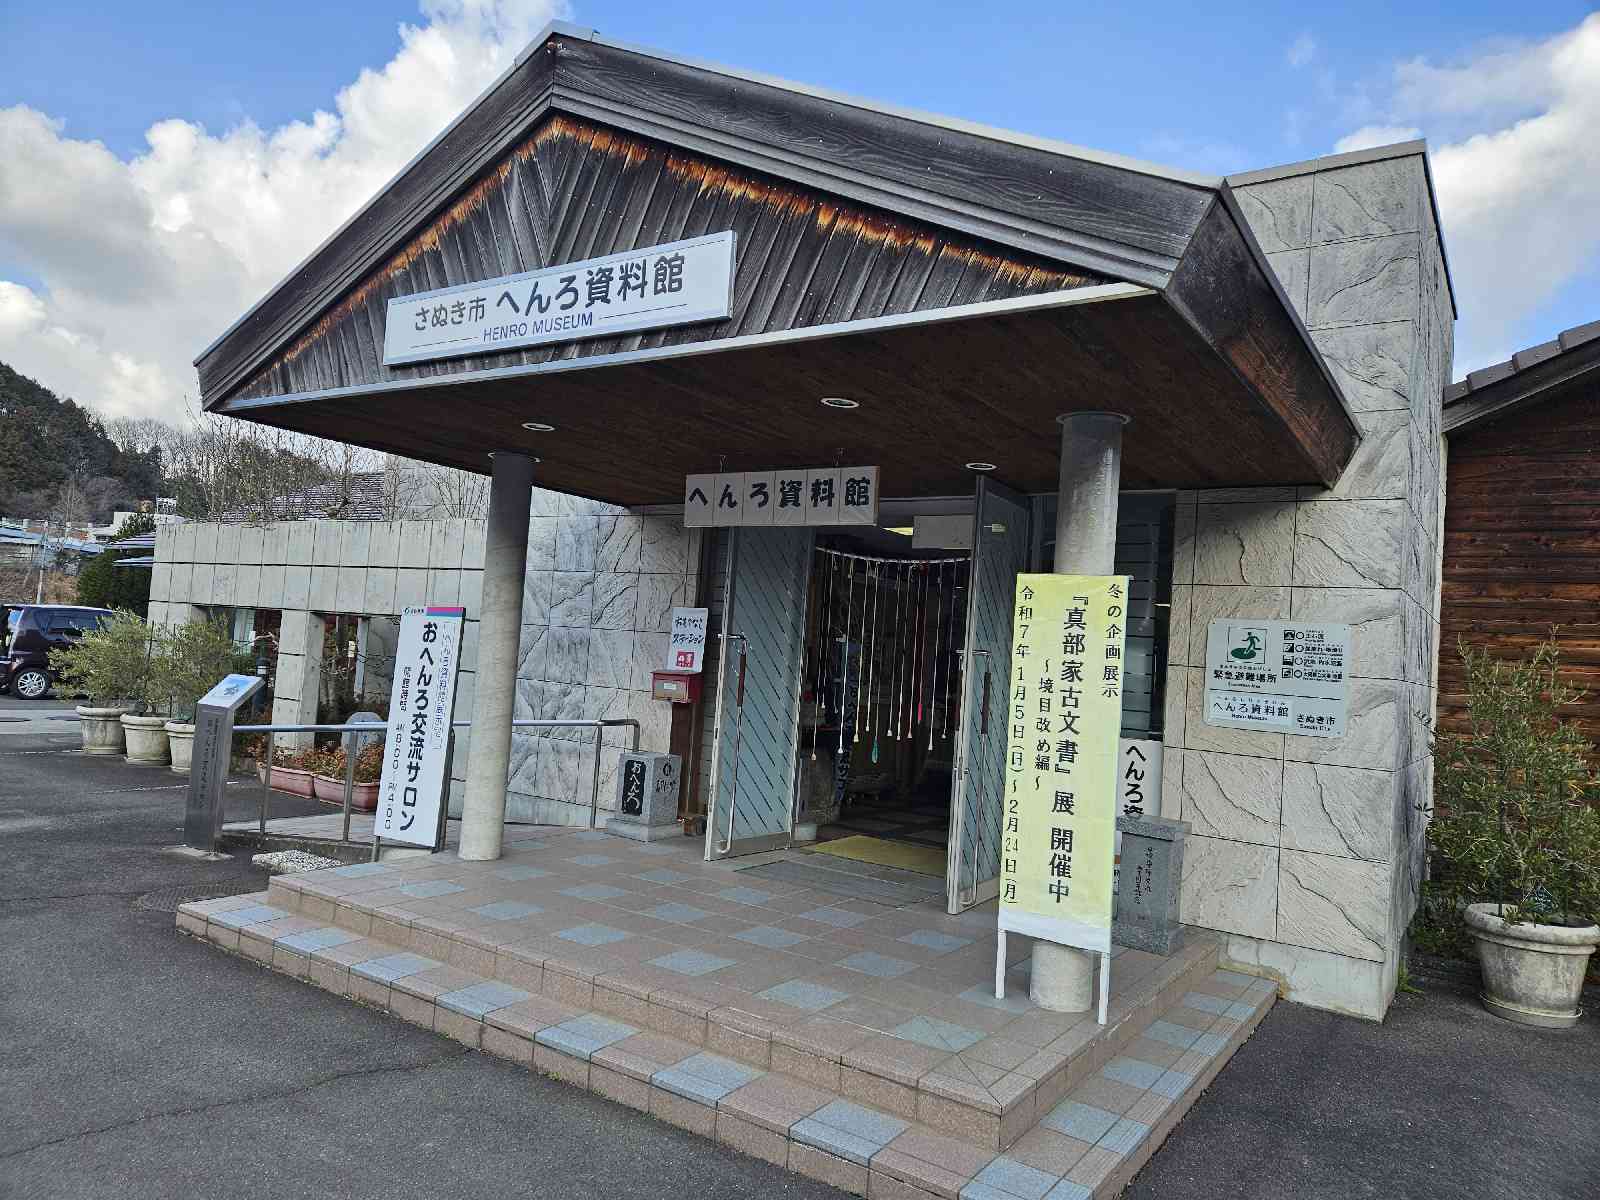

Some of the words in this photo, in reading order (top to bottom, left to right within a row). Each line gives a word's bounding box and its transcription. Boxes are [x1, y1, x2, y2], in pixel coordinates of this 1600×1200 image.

[415, 297, 487, 331] さぬき市
[497, 252, 685, 316] へんろ資料館
[484, 322, 527, 342] HENRO
[533, 312, 593, 335] MUSEUM
[689, 477, 870, 508] へんろ資料館
[1102, 583, 1123, 698] 冬の企画展示
[400, 622, 438, 831] おへんろ交流サロン
[1213, 702, 1289, 717] へんろ資料館
[1297, 713, 1336, 726] さぬき市
[626, 761, 641, 809] おへんろ
